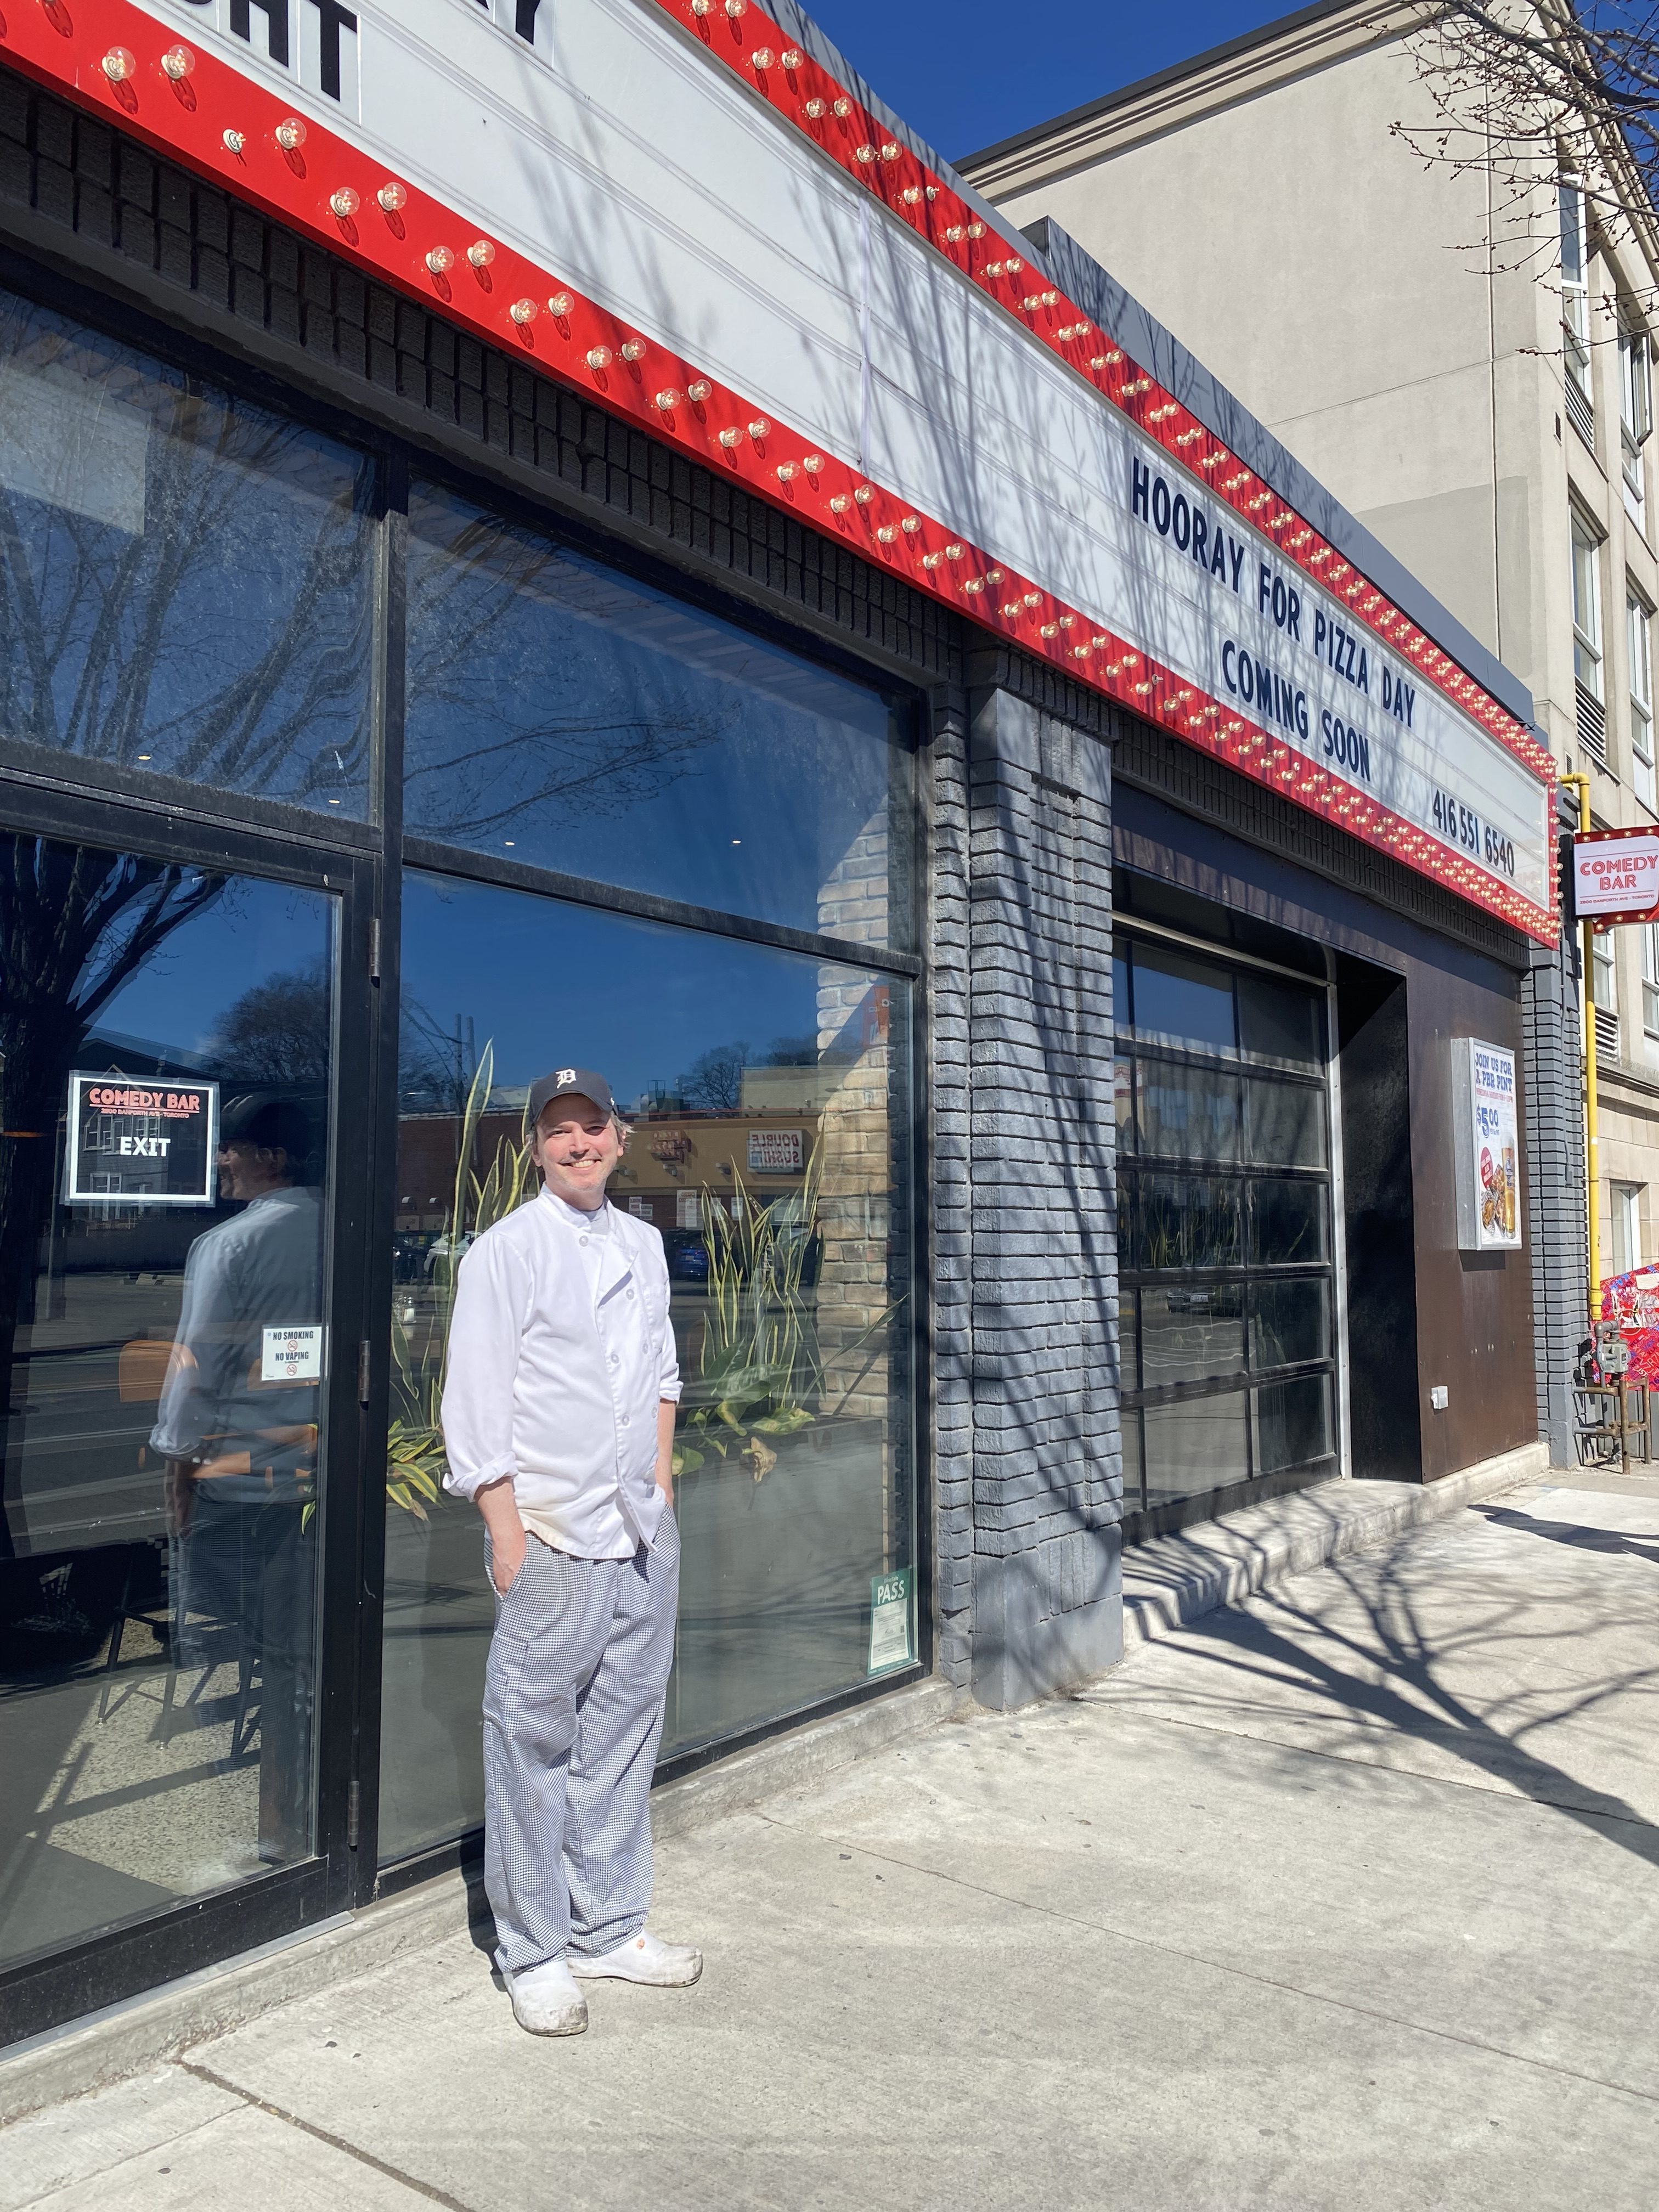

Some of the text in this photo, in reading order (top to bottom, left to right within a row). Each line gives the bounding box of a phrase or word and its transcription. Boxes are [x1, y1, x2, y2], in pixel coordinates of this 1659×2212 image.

[1131, 456, 1416, 729] HOORAY FOR PIZZA DAY
[1222, 639, 1370, 782] COMING SOON
[1433, 789, 1515, 877] 416 551 6540
[1580, 855, 1658, 876] COMEDY
[1600, 874, 1637, 890] BAR
[1475, 1053, 1513, 1076] JOIN US FOR
[1476, 1069, 1513, 1092] A PBR PINT
[89, 1088, 200, 1110] COMEDY BAR
[120, 1136, 171, 1156] EXIT
[273, 1330, 313, 1340] NO SMOKING
[275, 1351, 309, 1361] NO VAPING
[878, 1580, 904, 1605] PASS
